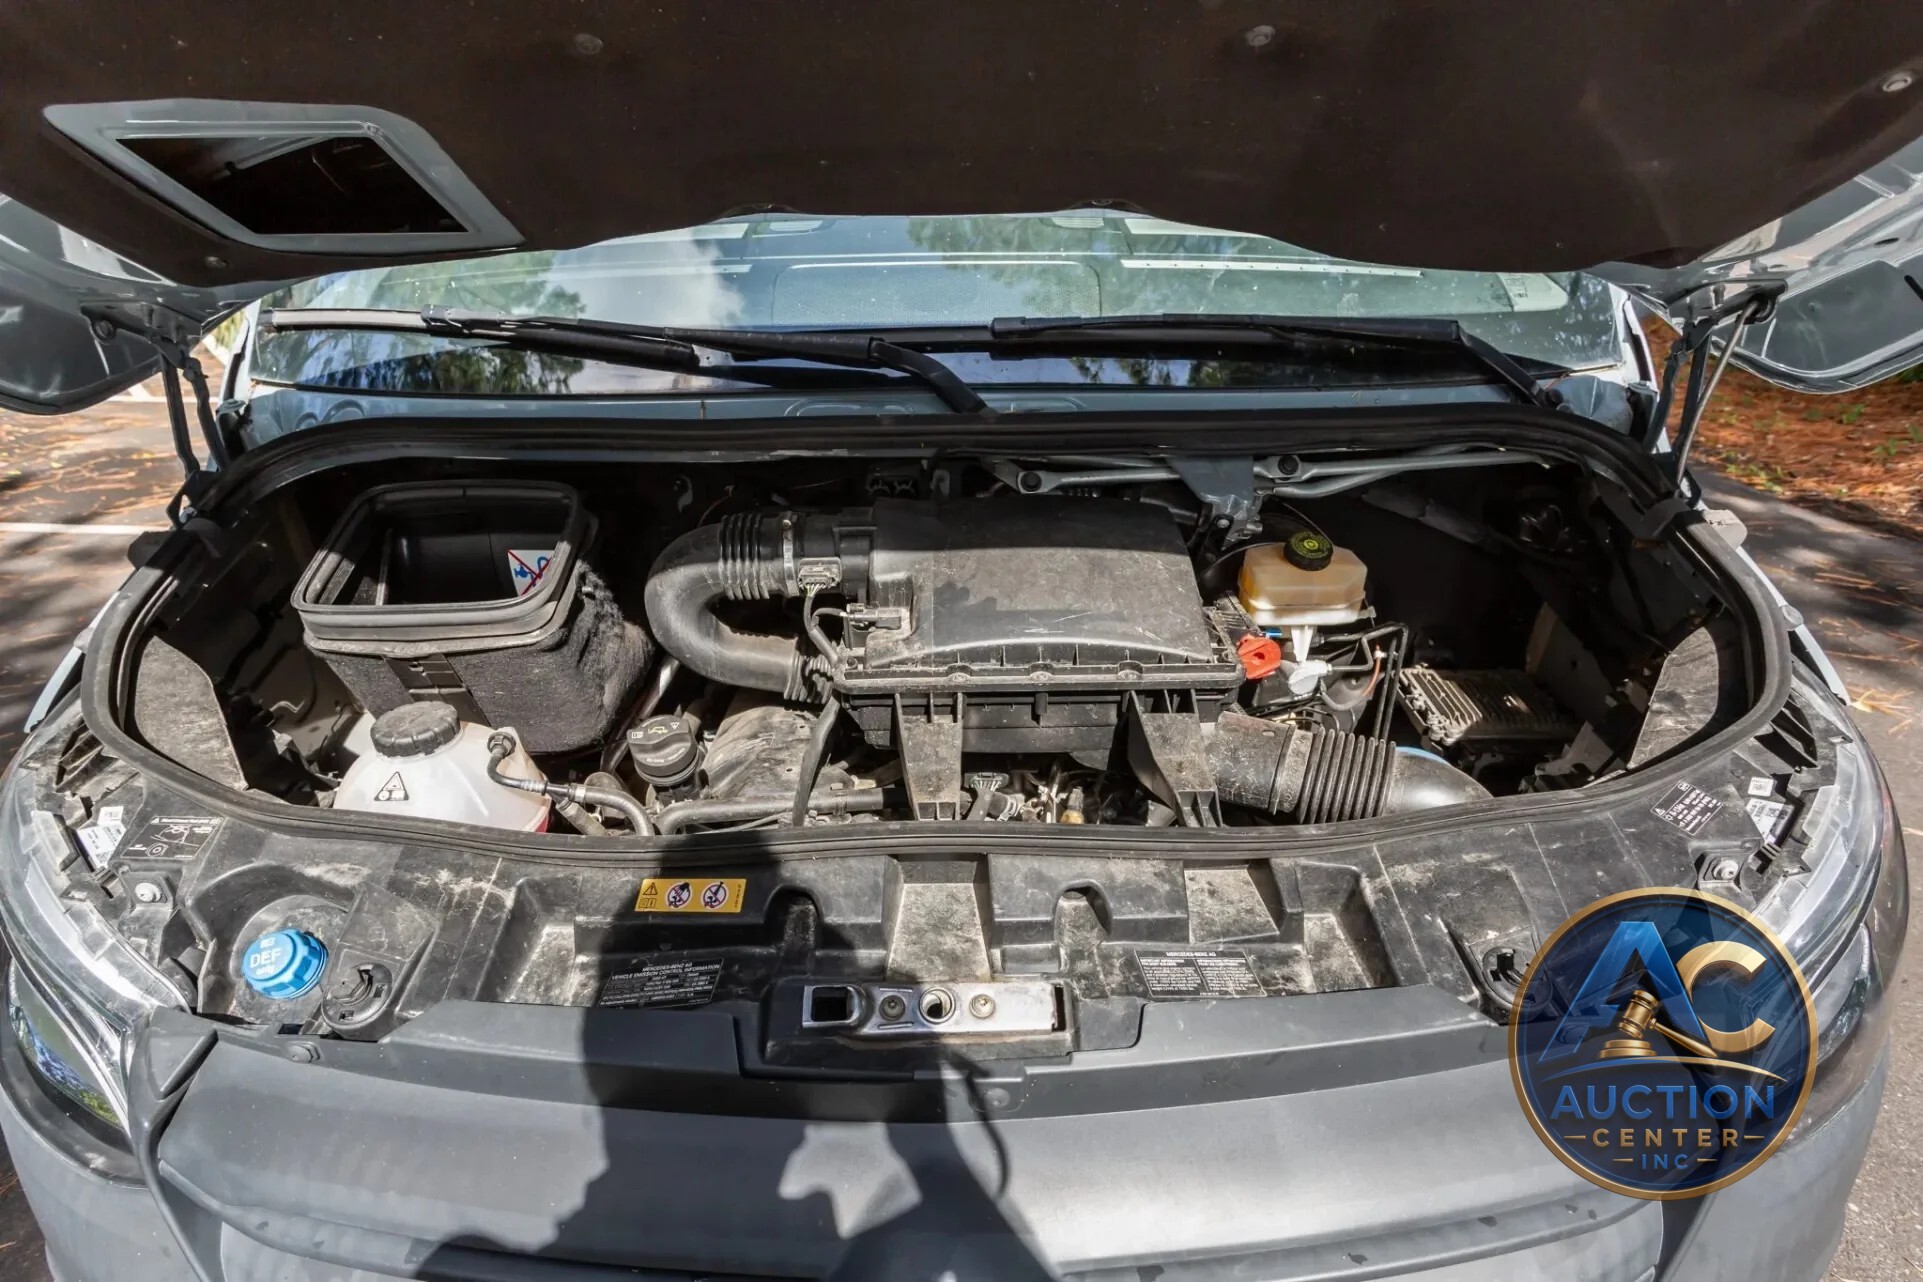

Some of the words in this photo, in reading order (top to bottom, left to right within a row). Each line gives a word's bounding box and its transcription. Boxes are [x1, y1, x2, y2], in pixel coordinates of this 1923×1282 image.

[250, 948, 282, 969] DEF
[642, 963, 684, 972] MERCEDES-BENZ
[684, 964, 720, 972] INFORMATION
